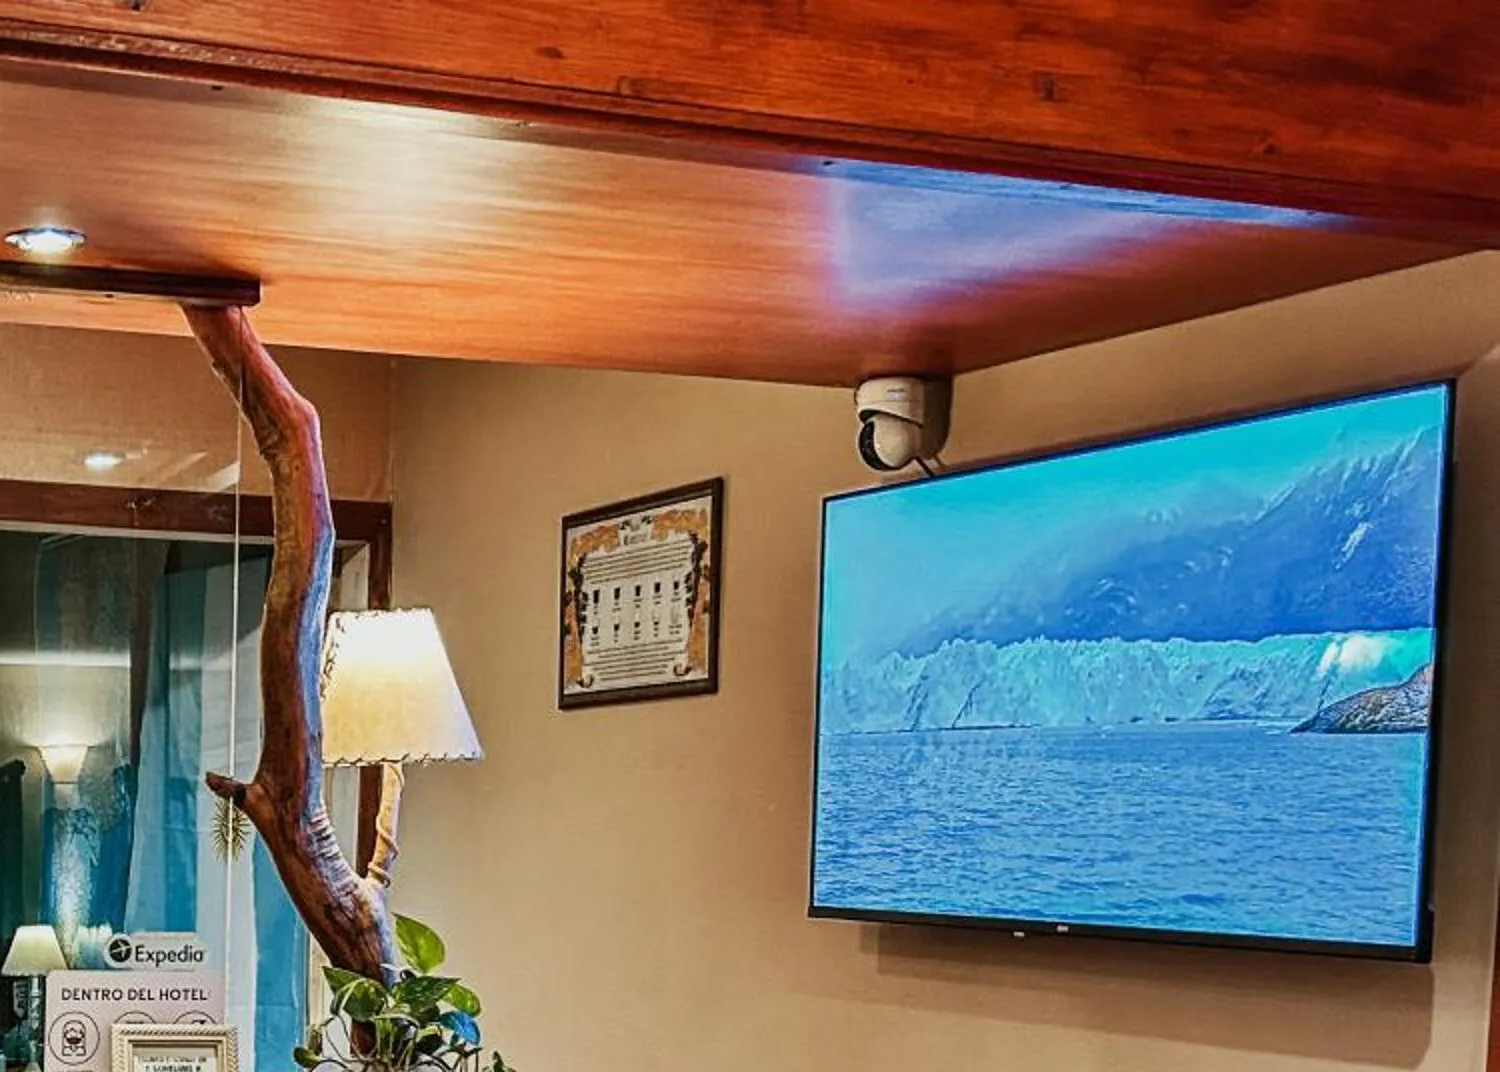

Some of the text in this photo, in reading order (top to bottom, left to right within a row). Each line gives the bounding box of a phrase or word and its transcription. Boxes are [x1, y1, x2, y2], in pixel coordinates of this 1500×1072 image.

[134, 944, 205, 968] Expedia
[60, 987, 208, 1001] DENTRO DEL HOTEL
